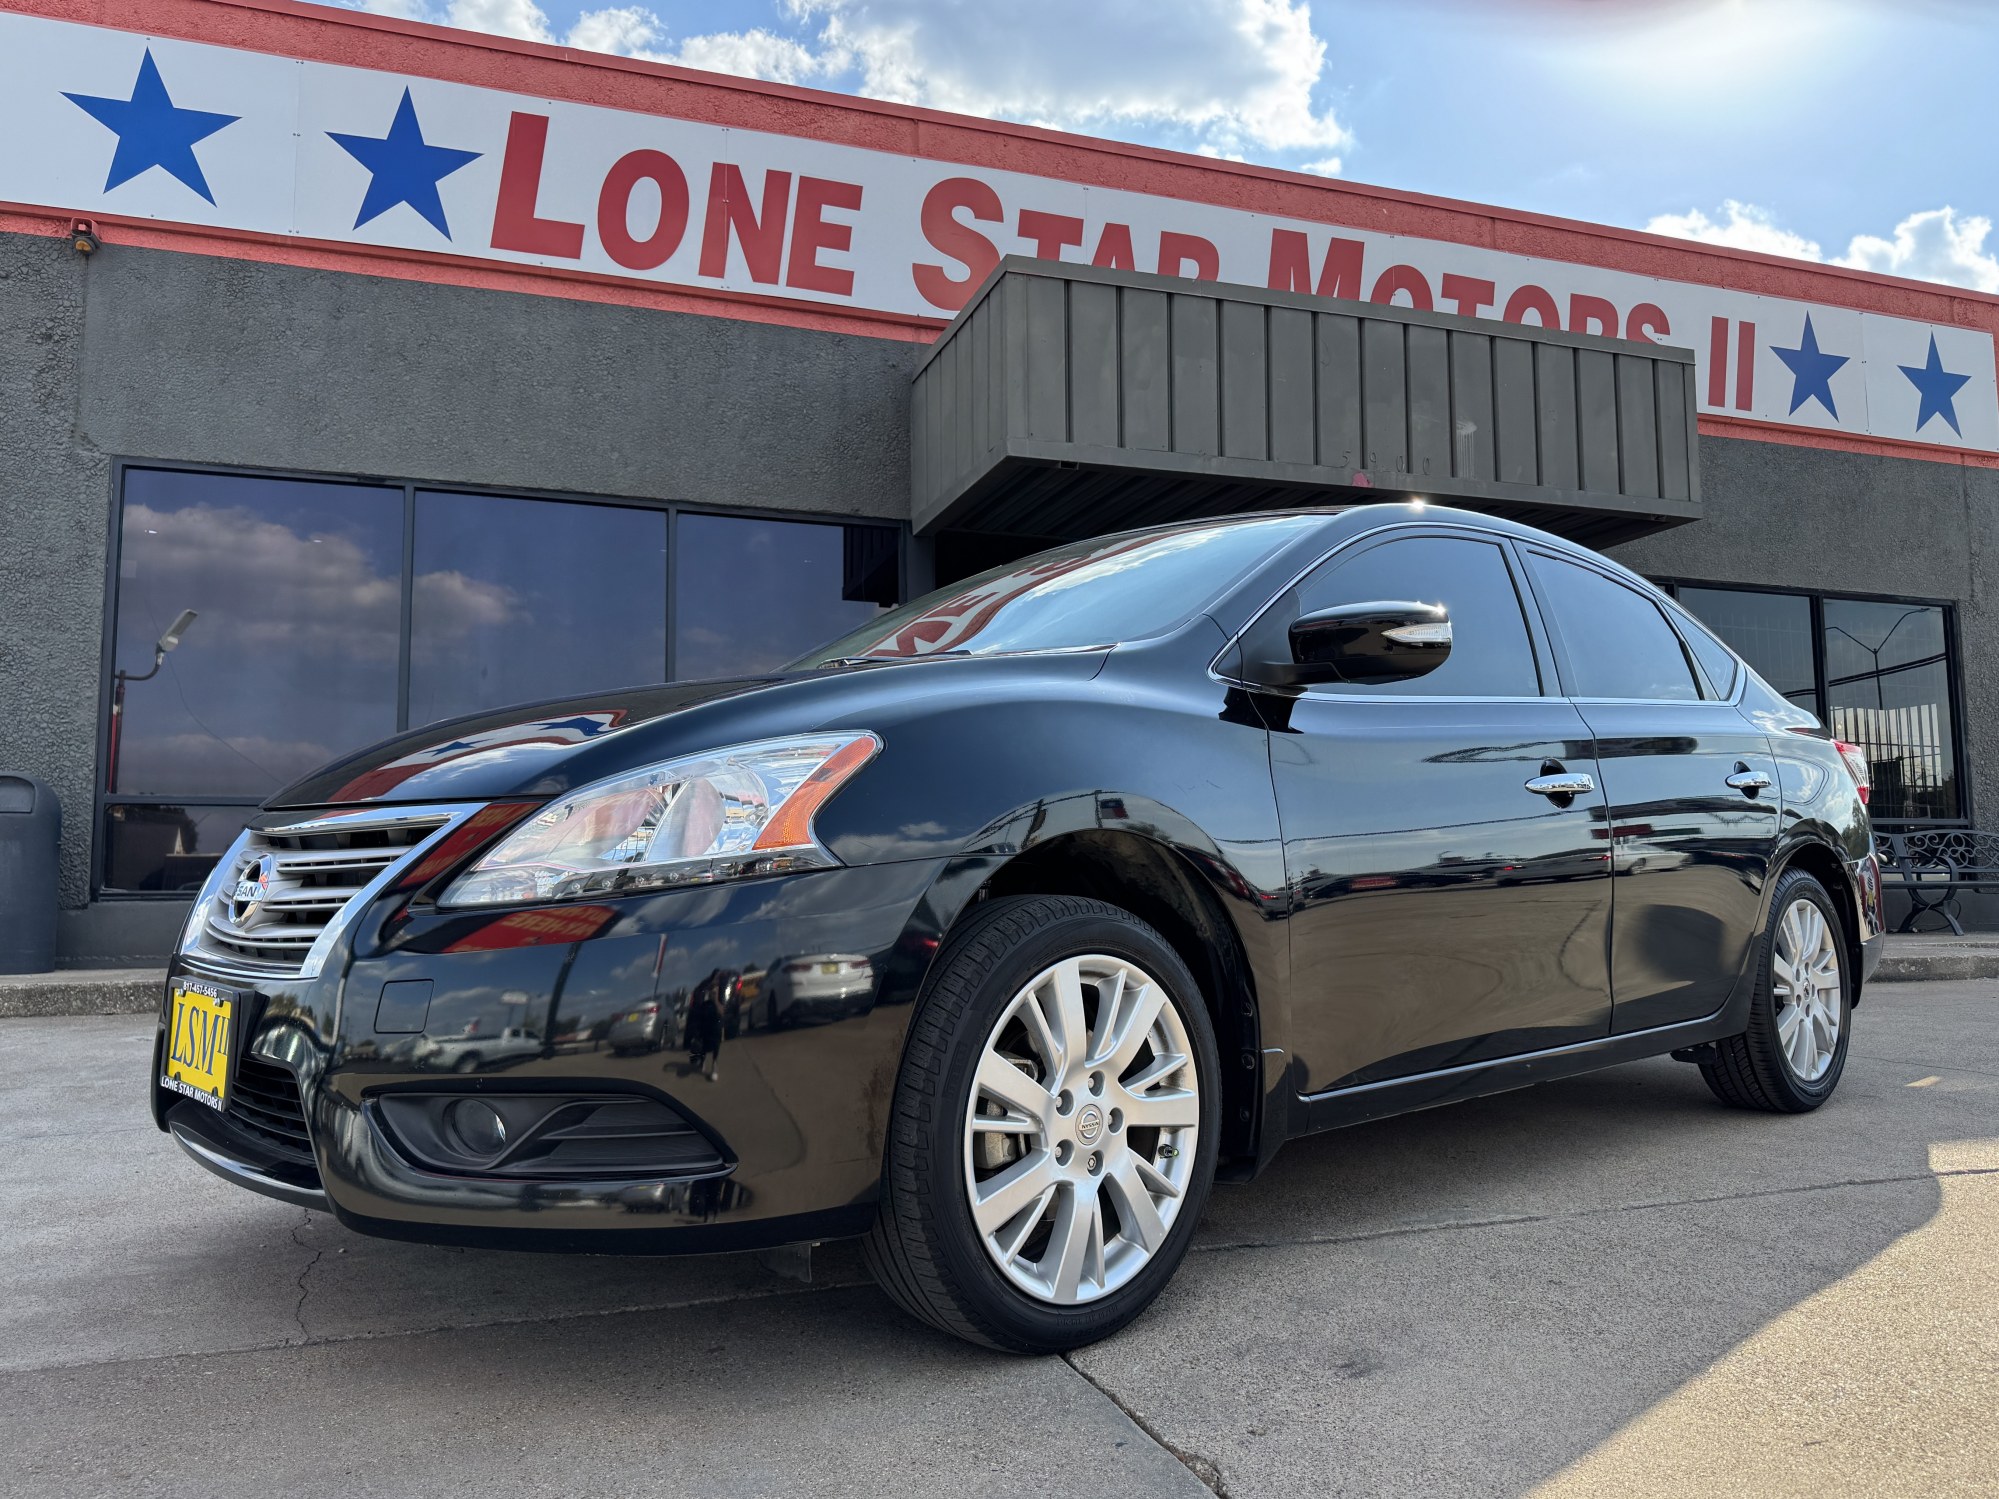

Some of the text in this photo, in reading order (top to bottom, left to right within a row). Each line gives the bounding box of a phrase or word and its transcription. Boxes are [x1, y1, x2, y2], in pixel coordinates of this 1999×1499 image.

[490, 111, 863, 296] LONE
[1708, 316, 1755, 411] II
[161, 1076, 178, 1091] LONE
[179, 1083, 194, 1098] STAR
[194, 1089, 218, 1109] MOTORS
